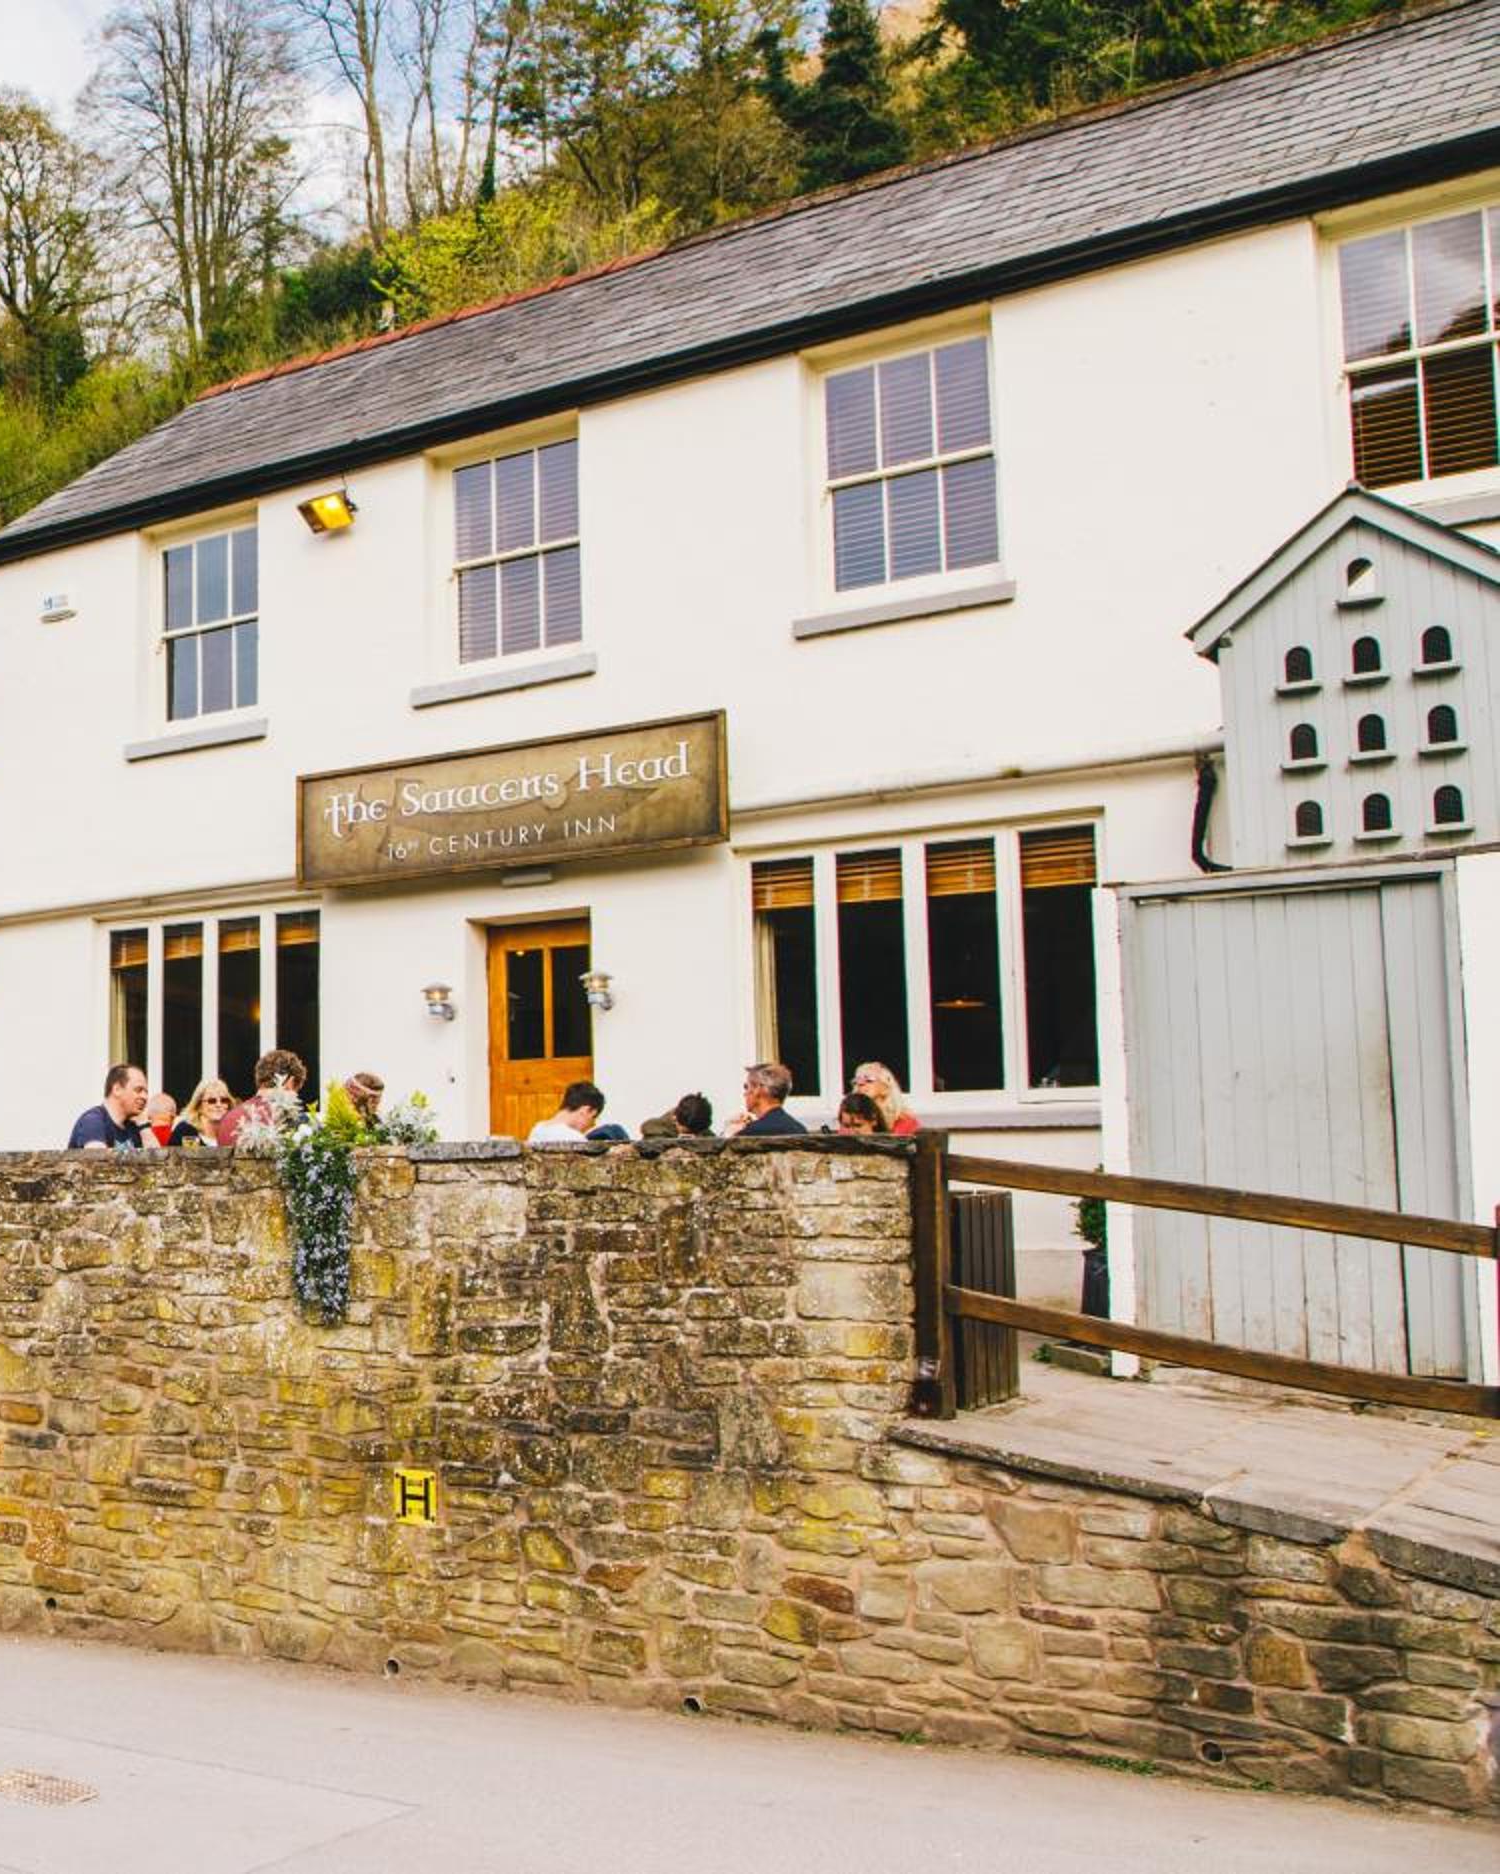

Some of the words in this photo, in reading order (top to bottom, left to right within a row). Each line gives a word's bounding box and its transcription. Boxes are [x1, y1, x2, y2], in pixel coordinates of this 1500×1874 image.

[324, 791, 388, 838] The
[401, 773, 560, 817] Saracens
[576, 741, 691, 791] Head
[429, 824, 546, 856] CENTURY
[564, 814, 616, 838] INN
[401, 1475, 430, 1520] H
